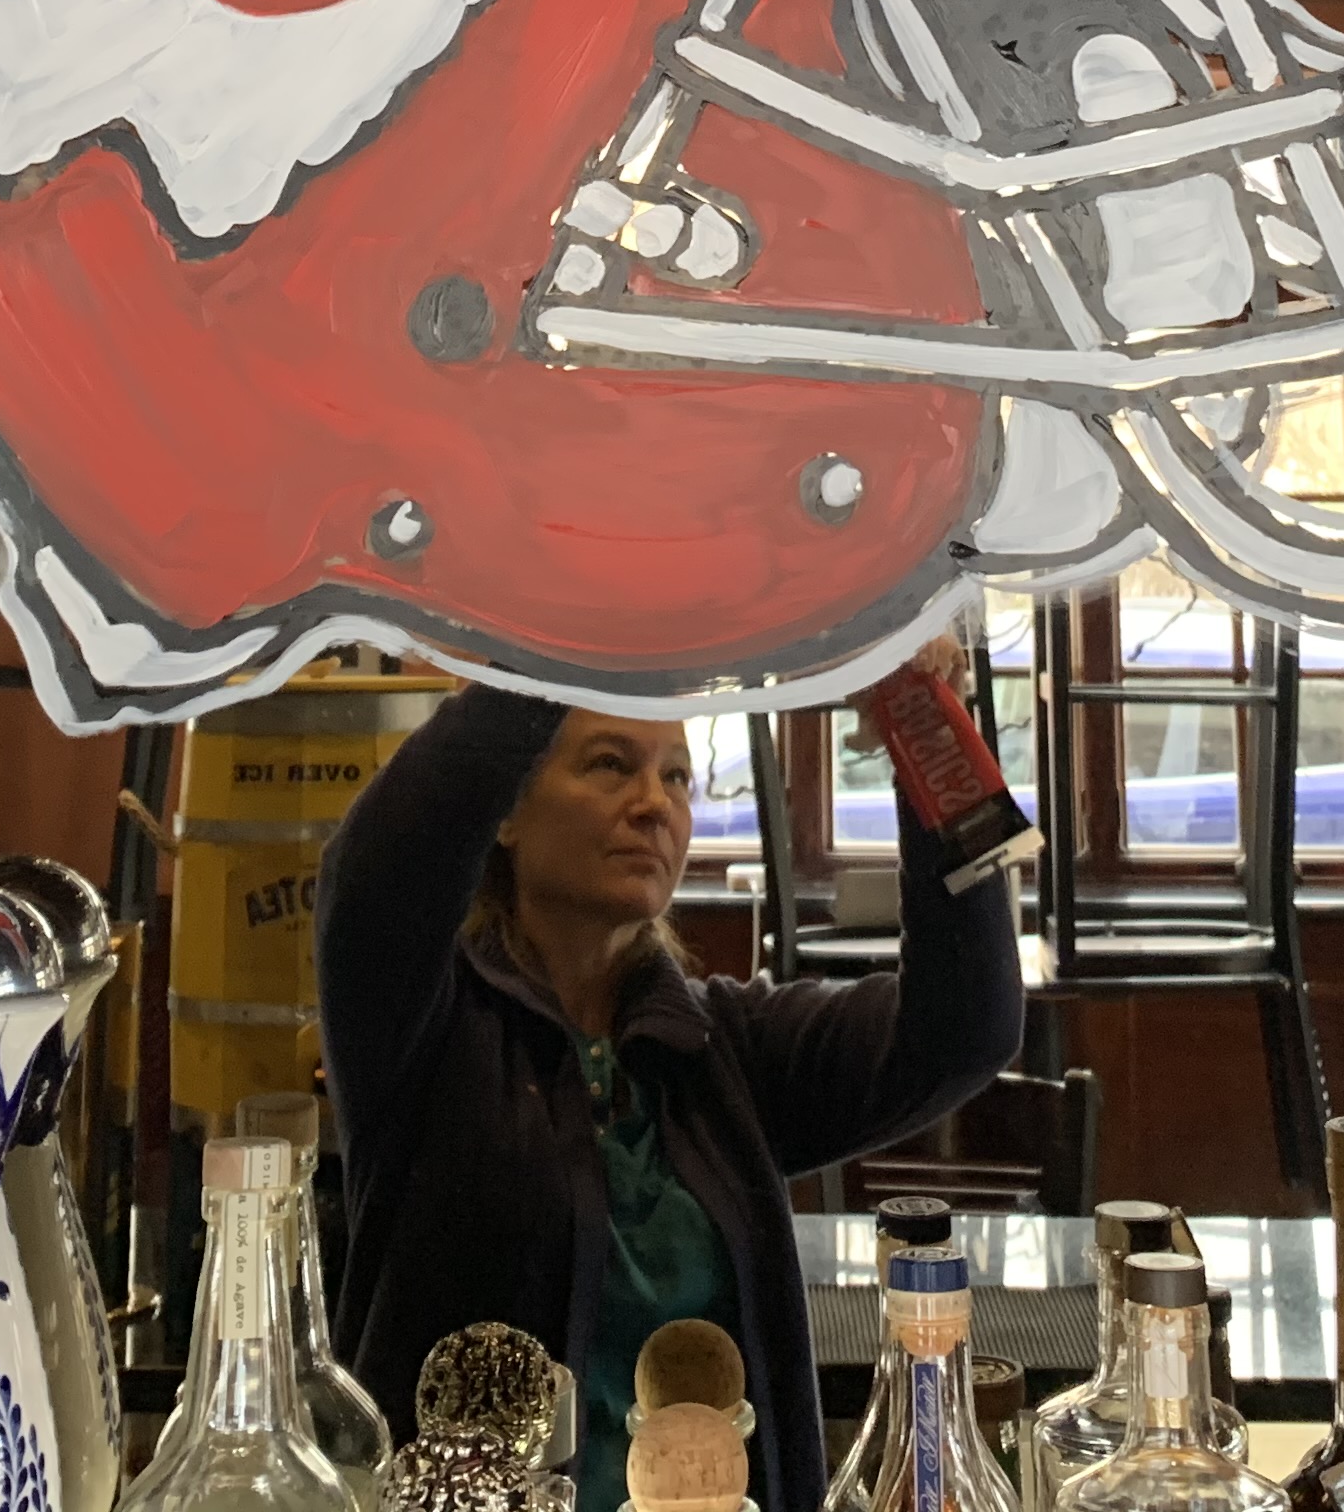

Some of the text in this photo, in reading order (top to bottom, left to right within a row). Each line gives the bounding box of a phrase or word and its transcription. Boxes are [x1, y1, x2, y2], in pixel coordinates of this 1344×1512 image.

[237, 1212, 250, 1248] 100%
[236, 1255, 248, 1274] de
[233, 1282, 247, 1330] Agave
